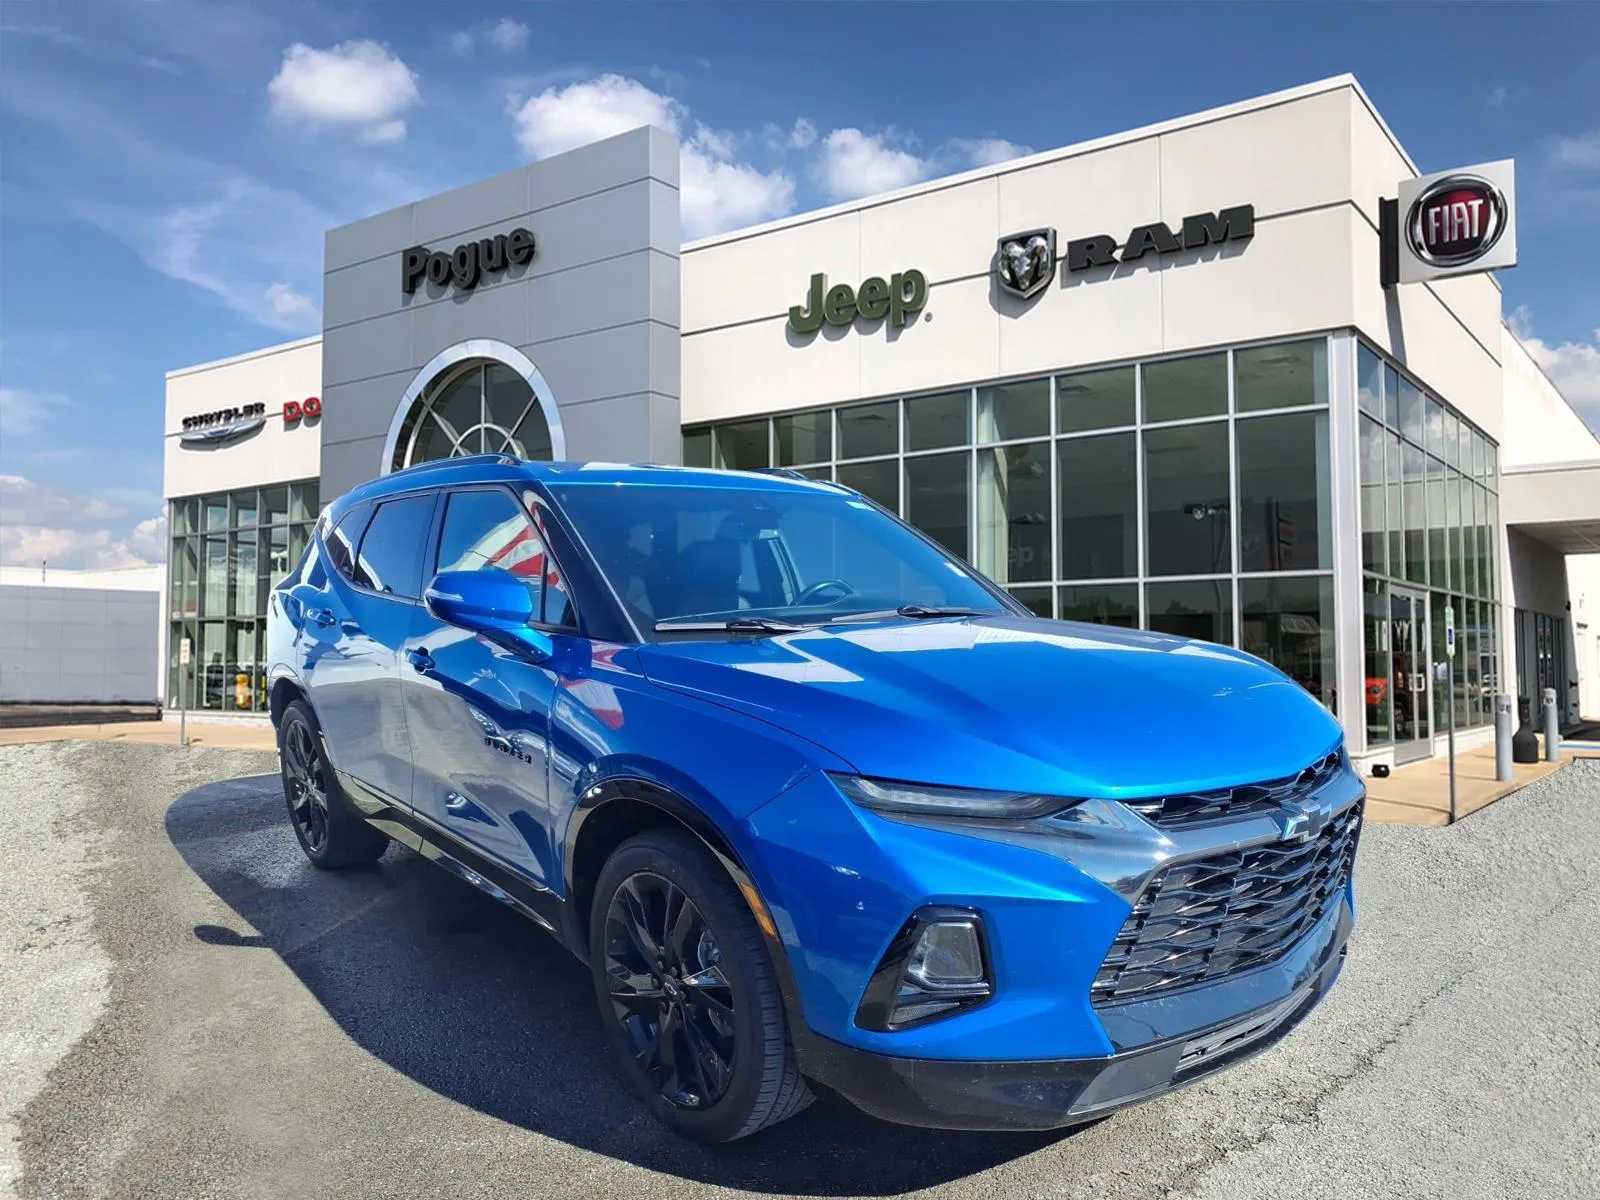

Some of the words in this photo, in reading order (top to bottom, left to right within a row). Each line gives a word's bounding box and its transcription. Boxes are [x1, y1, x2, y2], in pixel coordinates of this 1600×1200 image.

[1066, 203, 1255, 272] RAM
[1428, 198, 1484, 246] FIAT
[402, 227, 536, 294] Pogue
[787, 267, 929, 334] Jeep
[182, 402, 266, 429] CHRYSLER
[283, 396, 322, 421] DO
